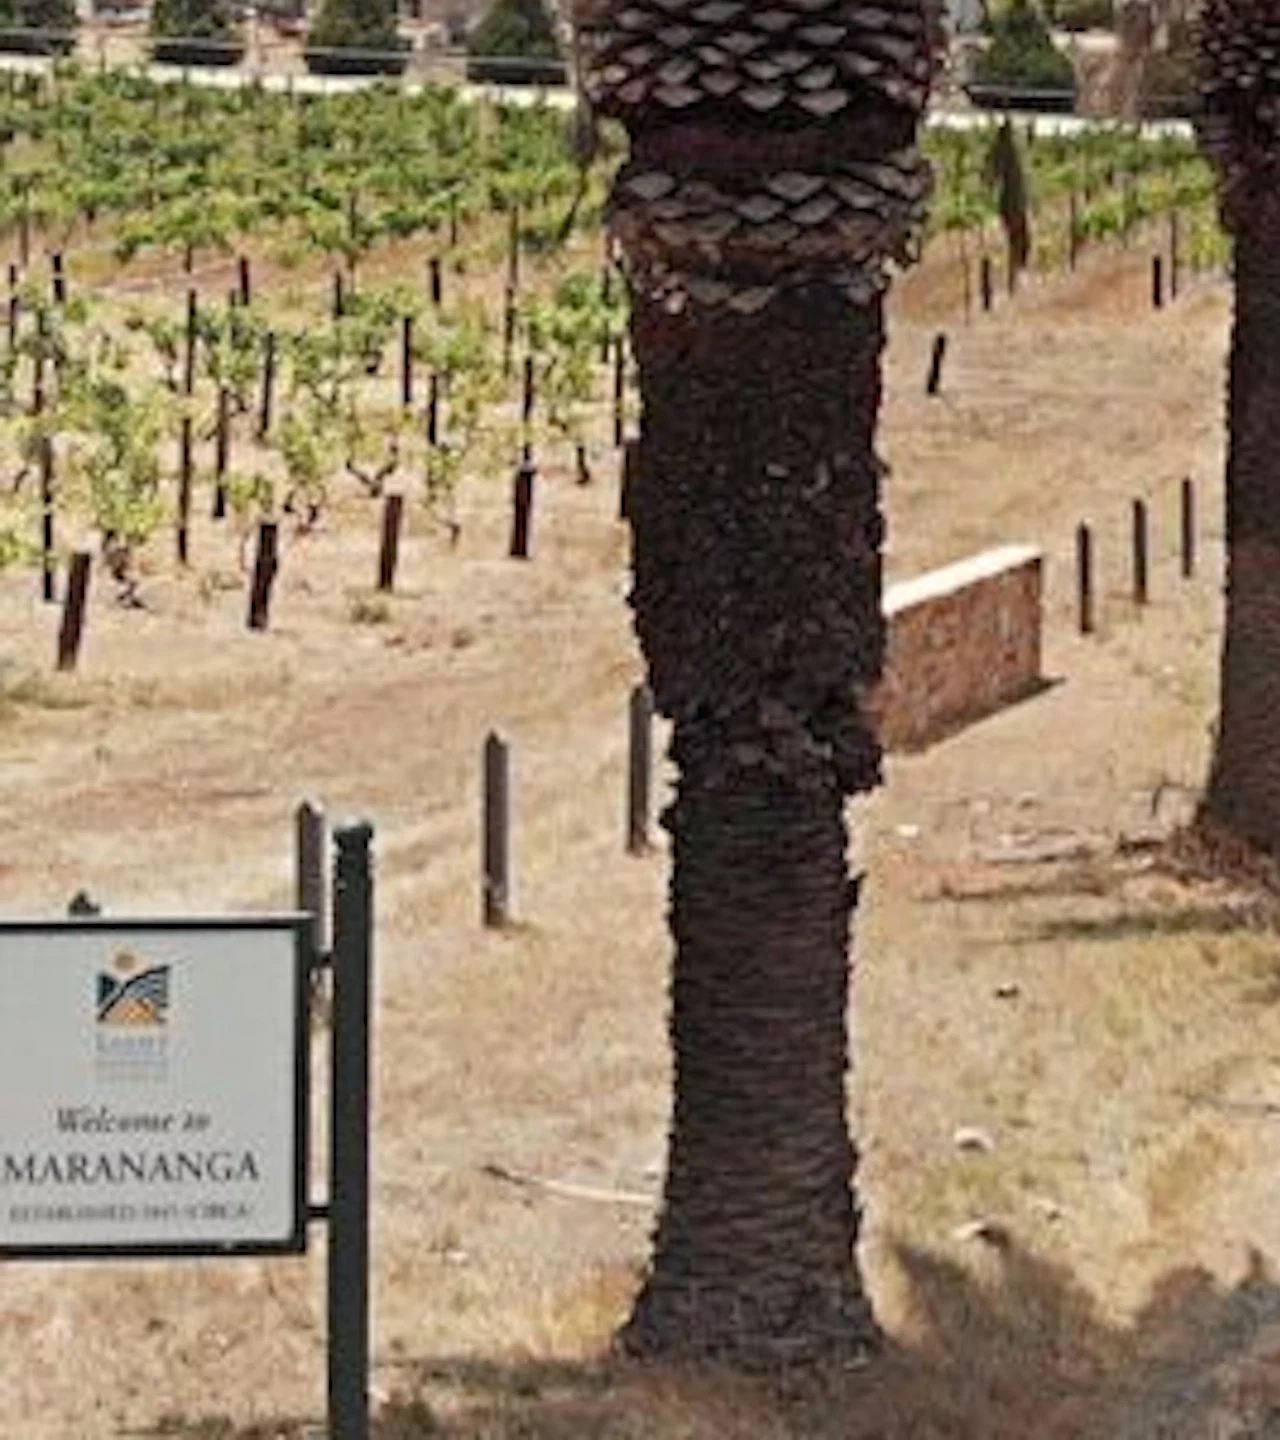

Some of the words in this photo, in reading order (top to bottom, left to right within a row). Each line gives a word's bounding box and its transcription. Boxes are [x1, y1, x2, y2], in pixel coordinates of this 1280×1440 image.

[57, 1104, 176, 1134] Welcome
[183, 1110, 212, 1133] to
[3, 1150, 259, 1185] MARANANGA
